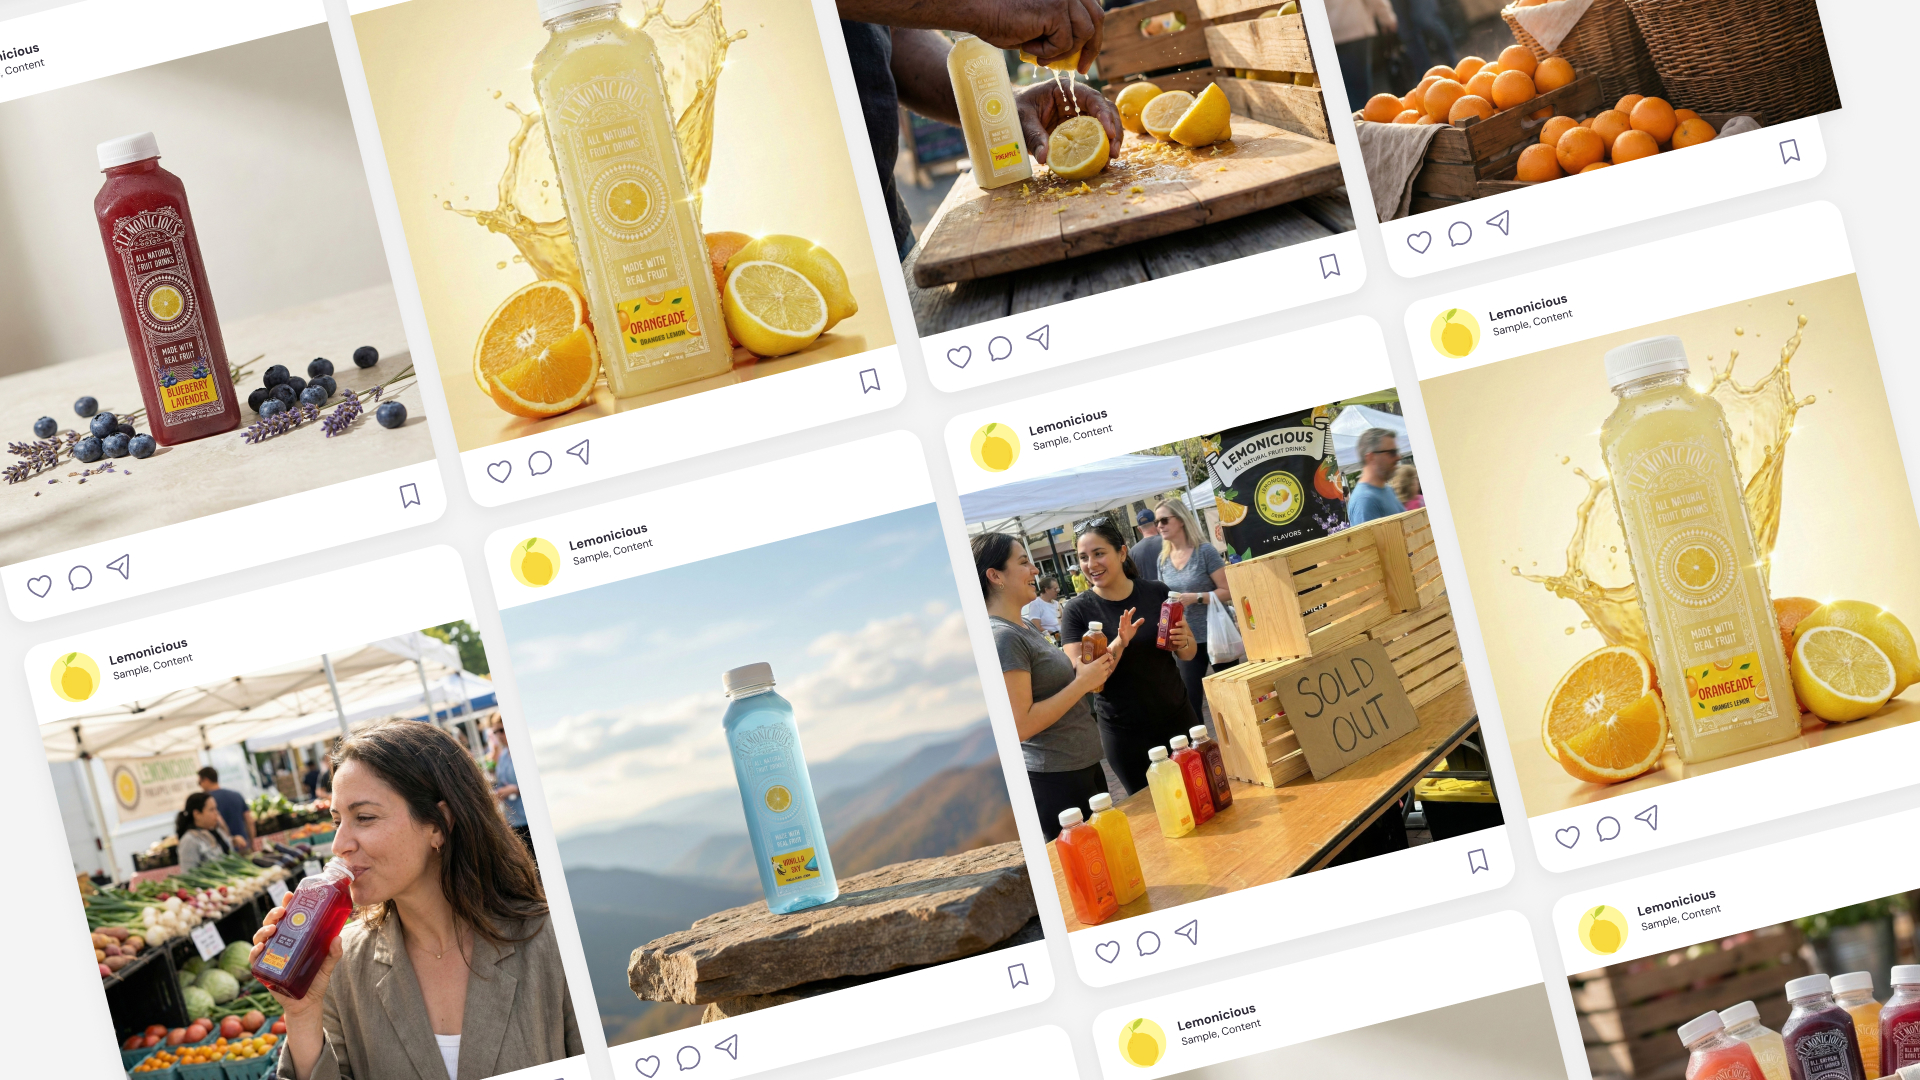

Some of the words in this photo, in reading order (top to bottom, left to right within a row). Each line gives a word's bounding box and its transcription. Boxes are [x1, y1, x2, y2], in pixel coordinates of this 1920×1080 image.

[5, 59, 45, 75] Content
[560, 80, 650, 124] LEMONICIOUS
[587, 133, 602, 146] ALL
[602, 125, 637, 141] NATURAL
[589, 145, 611, 158] FRUIT
[613, 137, 641, 153] DRINKS
[995, 149, 1017, 162] PINEAPPLE
[116, 214, 181, 247] LEMONICIOUS
[135, 254, 147, 264] ALL
[147, 247, 173, 260] NATURAL
[137, 262, 153, 272] FRUIT
[154, 256, 175, 268] DRINKS
[622, 260, 645, 275] MADE
[645, 255, 666, 269] WITH
[625, 273, 646, 287] REAL
[647, 267, 669, 282] FRUIT
[1489, 295, 1568, 322] Lemonicious
[630, 310, 688, 336] ORANGEADE
[1493, 320, 1531, 336] Sample,
[1533, 309, 1573, 326] Content
[161, 345, 178, 356] MADE
[178, 341, 194, 352] WITH
[639, 334, 666, 346] ORANGES
[666, 329, 686, 341] LEMON
[164, 355, 179, 365] REAL
[179, 351, 195, 362] FRUIT
[166, 379, 209, 398] BLUEBERRY
[171, 391, 210, 409] LAVENDER
[1029, 410, 1108, 436] Lemonicious
[1033, 435, 1071, 451] Sample,
[1073, 424, 1113, 441] Content
[1222, 431, 1314, 470] LEMONICIOUS
[1234, 465, 1244, 473] ALL
[1243, 453, 1267, 467] NATURAL
[1268, 447, 1284, 457] FRUIT
[1285, 445, 1306, 453] DRINKS
[1628, 445, 1717, 490] LEMONICIOUS
[1261, 477, 1292, 495] LEMONICIOUS
[1655, 500, 1670, 512] ALL
[1670, 490, 1706, 507] NATURAL
[1657, 511, 1679, 524] FRUIT
[1681, 503, 1709, 519] DRINKS
[569, 524, 648, 551] Lemonicious
[1272, 529, 1302, 542] FLAVORS
[573, 550, 612, 566] Sample,
[613, 538, 653, 556] Content
[1690, 626, 1713, 640] MADE
[1714, 620, 1735, 634] WITH
[109, 639, 188, 666] Lemonicious
[1693, 639, 1714, 652] REAL
[1715, 633, 1737, 647] FRUIT
[113, 665, 152, 680] Sample,
[153, 653, 194, 670] Content
[1297, 657, 1375, 718] SOLD
[1698, 675, 1756, 701] ORANGEADE
[1711, 701, 1734, 713] ORANGES
[1332, 692, 1390, 753] OUT
[739, 728, 790, 754] LEMONICIOUS
[776, 840, 789, 848] REAL
[782, 854, 806, 867] VANILLA
[790, 864, 801, 874] SKY
[1637, 890, 1716, 917] Lemonicious
[1641, 916, 1680, 931] Sample,
[1681, 904, 1722, 921] Content
[1177, 1005, 1256, 1031] Lemonicious
[1181, 1030, 1220, 1046] Sample,
[1221, 1019, 1262, 1036] Content
[1799, 1033, 1846, 1057] LEMONICIOUS
